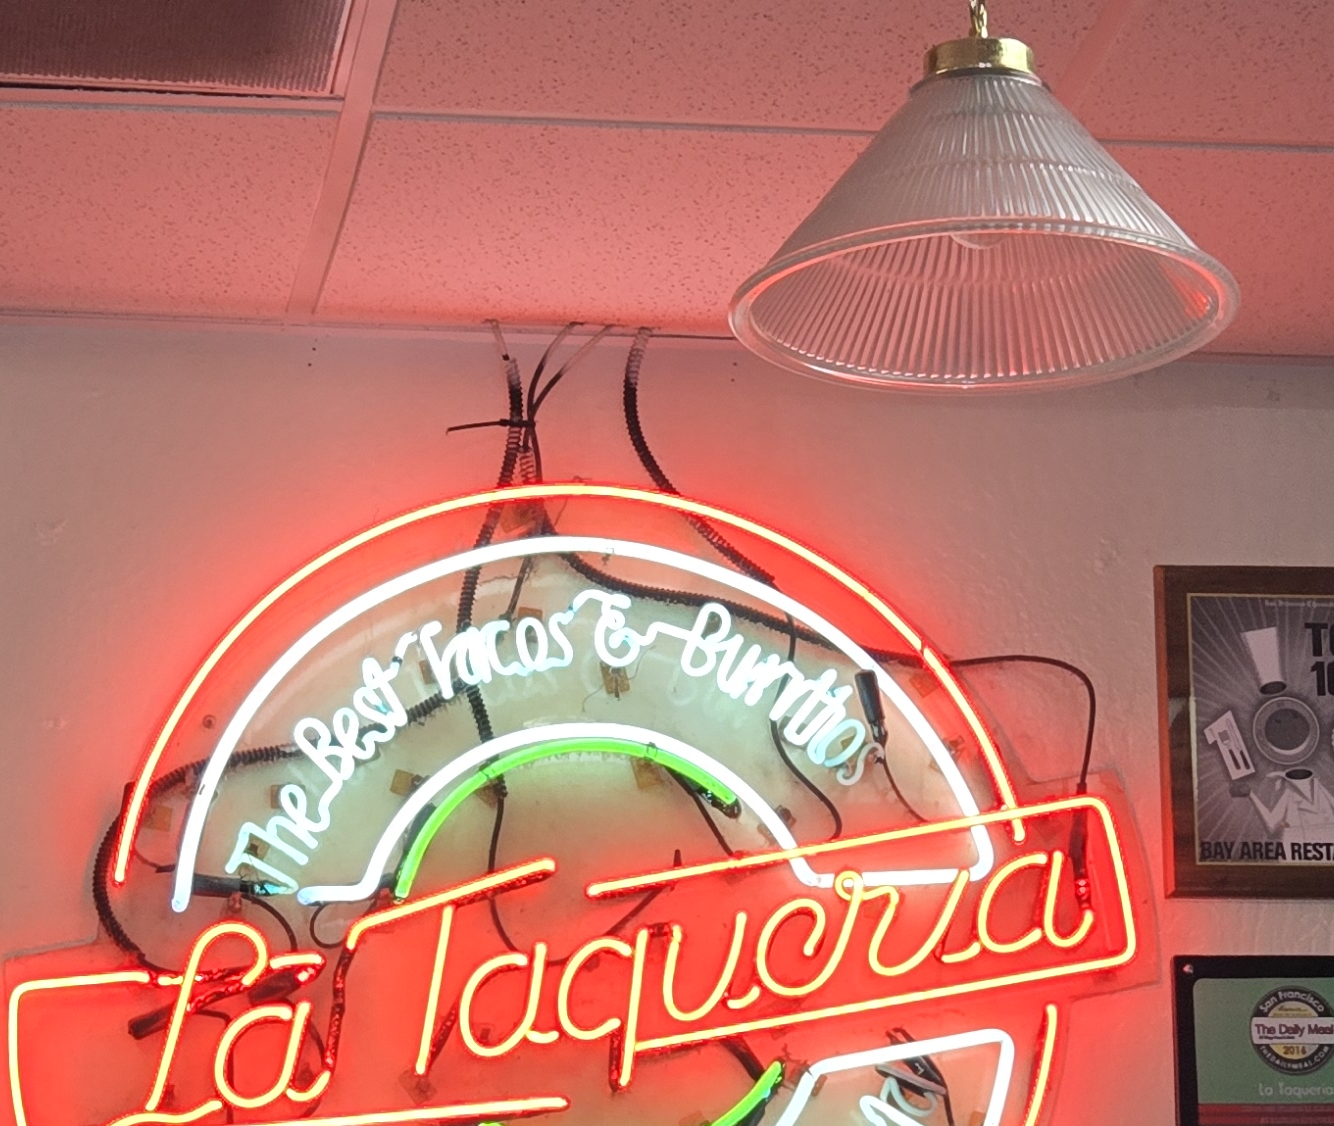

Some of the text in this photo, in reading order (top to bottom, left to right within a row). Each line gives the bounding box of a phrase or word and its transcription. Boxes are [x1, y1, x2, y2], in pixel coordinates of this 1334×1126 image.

[225, 784, 332, 895] The
[293, 656, 400, 785] Best
[417, 608, 573, 685] Tacos
[679, 602, 887, 786] Burritos
[1199, 841, 1234, 861] BAY
[1239, 841, 1287, 861] AREA
[348, 851, 1095, 1088] Taqueria
[1258, 991, 1325, 1013] San Francisco
[1254, 1023, 1276, 1035] The
[1279, 1023, 1306, 1037] Daily
[1308, 1023, 1334, 1035] Meal
[1258, 1082, 1334, 1099] La Taqueria
